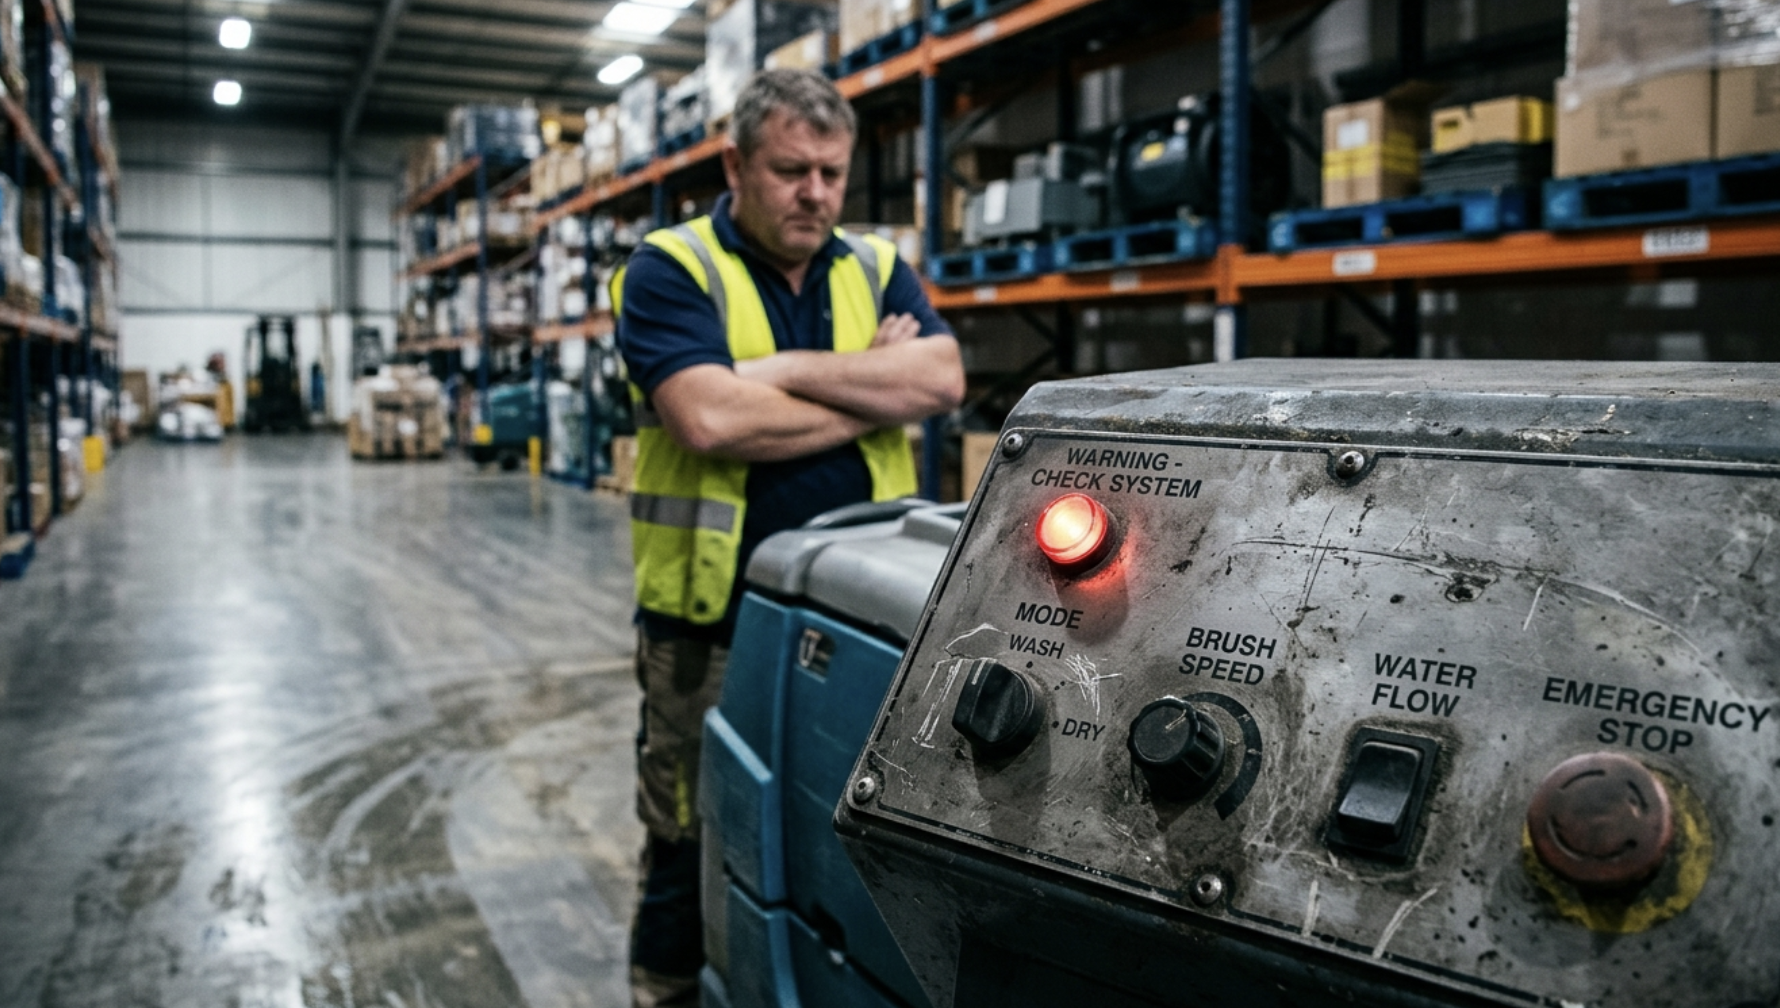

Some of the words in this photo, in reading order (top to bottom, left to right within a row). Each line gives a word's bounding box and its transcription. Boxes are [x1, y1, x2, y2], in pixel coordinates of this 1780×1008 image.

[1067, 447, 1170, 471] WARNING
[1031, 468, 1105, 492] CHECK
[1109, 474, 1202, 499] SYSTEM
[1015, 602, 1084, 630] MODE
[1008, 633, 1065, 660] WASH
[1186, 628, 1277, 660] BRUSH
[1178, 653, 1265, 686] SPEED
[1374, 653, 1477, 689] WATER
[1371, 683, 1460, 718] FLOW
[1542, 677, 1771, 733] EMERGENCY
[1061, 718, 1106, 742] DRY
[1597, 718, 1693, 755] STOP
